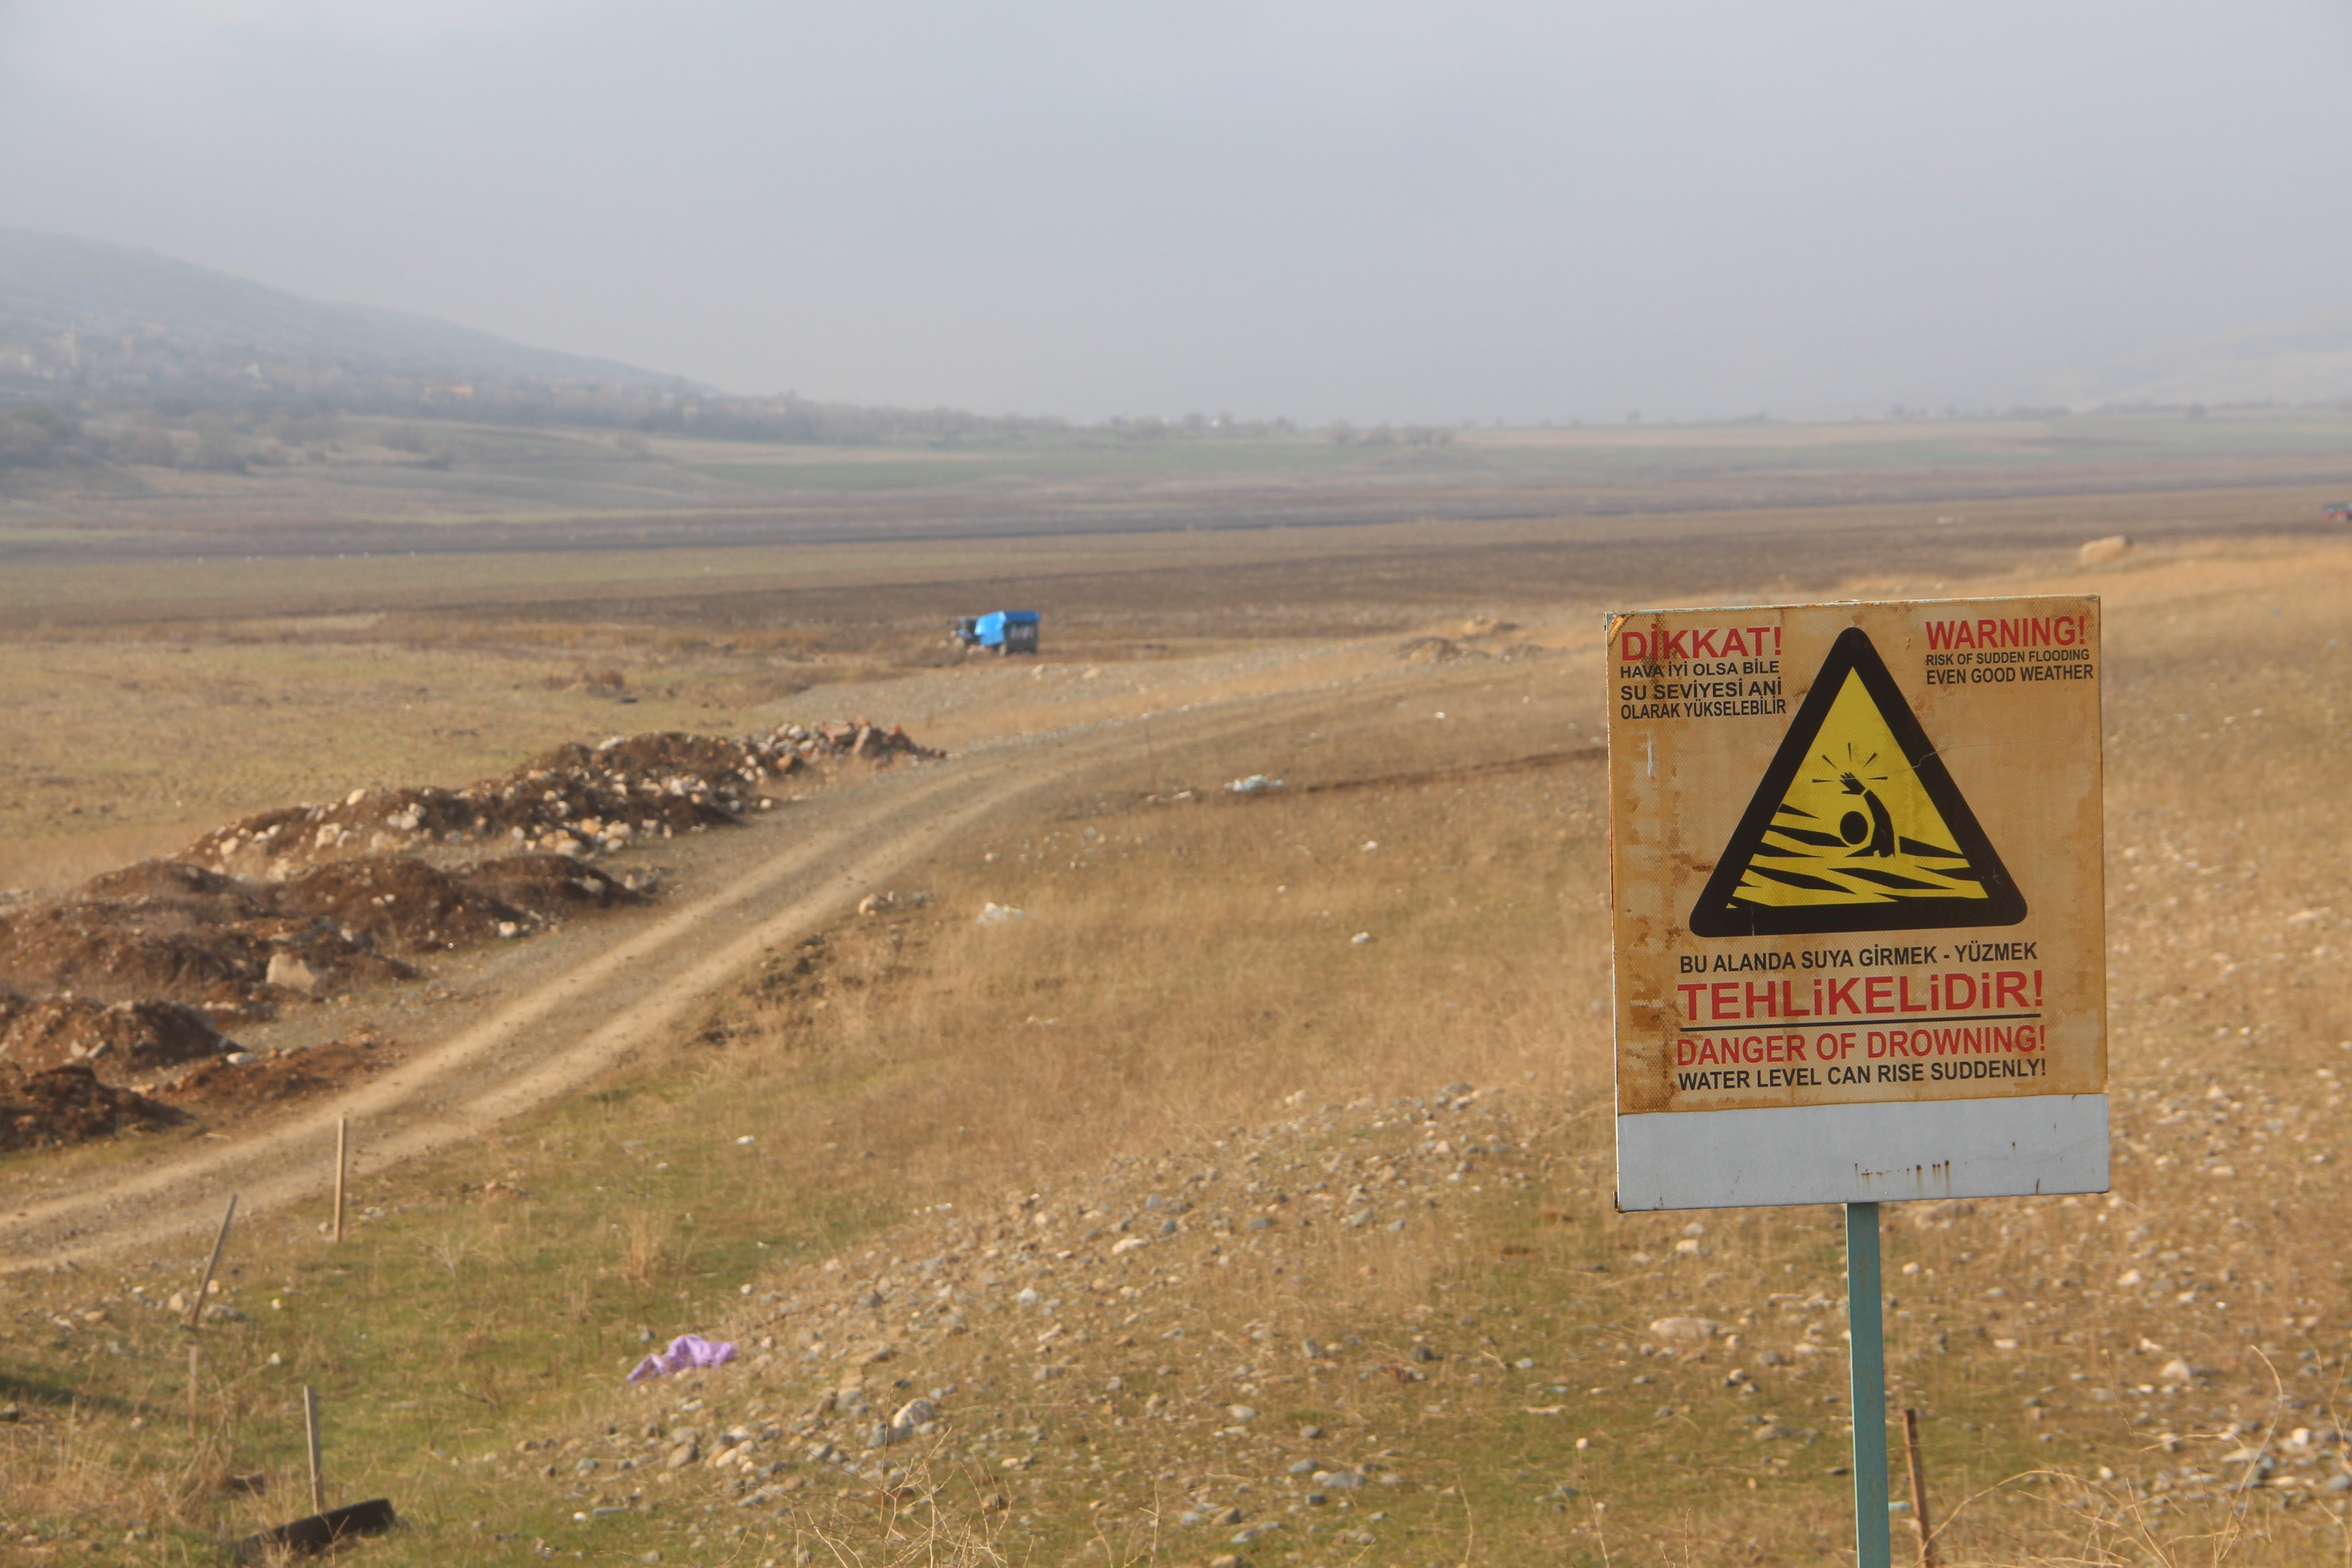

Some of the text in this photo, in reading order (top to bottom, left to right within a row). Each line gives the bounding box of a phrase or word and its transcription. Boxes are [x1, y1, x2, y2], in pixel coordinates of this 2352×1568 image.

[1622, 623, 1782, 661] DİKKAT!
[1925, 616, 2085, 650] WARNING!
[1620, 658, 1780, 678] HAVA İYİ OLSA BİLE
[1926, 649, 2090, 666] RISK OF SUDDEN FLOODING
[1927, 664, 2094, 685] EVEN GOOD WEATHER
[1620, 677, 1782, 701] SU SEVİYESİ ANİ
[1621, 696, 1786, 719] OLARAK YÜKSELEBİLİR
[1680, 955, 1707, 973] BU
[1713, 952, 1796, 972] ALANDA
[1801, 950, 1854, 969] SUYA
[1859, 944, 1937, 967] GİRMEK
[1954, 940, 2037, 963] YÜZMEK
[1677, 1025, 2046, 1066] DANGER OF DROWNING!
[1678, 1058, 2046, 1090] WATER LEVEL CAN RISE SUDDENLY!
